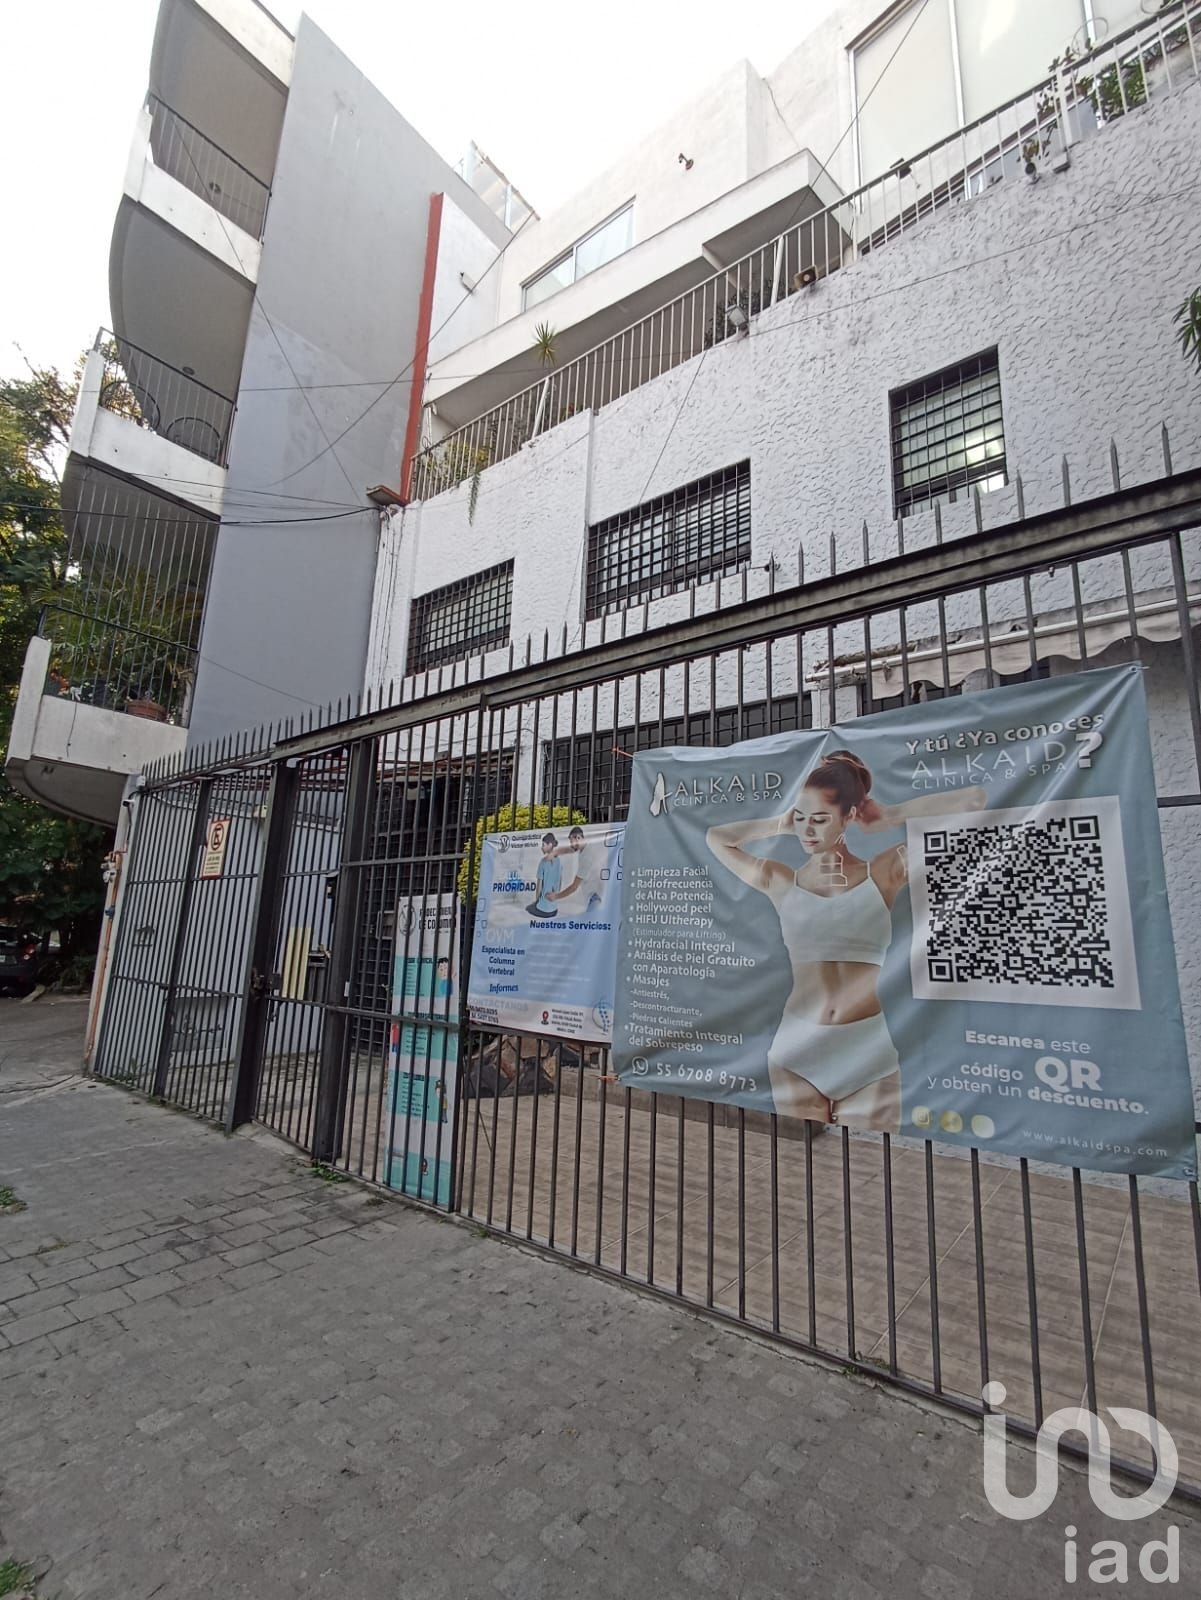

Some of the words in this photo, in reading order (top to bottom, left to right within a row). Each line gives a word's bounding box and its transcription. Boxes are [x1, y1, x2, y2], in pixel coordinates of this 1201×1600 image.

[905, 739, 920, 755] Y
[923, 734, 949, 752] tú
[954, 730, 998, 749] ¿Ya
[1003, 713, 1105, 742] conoces
[1004, 771, 1017, 780] &
[1029, 763, 1067, 777] SPA
[674, 772, 782, 798] ALKAID
[735, 792, 745, 802] &
[753, 790, 782, 801] SPA
[637, 867, 681, 878] Limpieza
[682, 866, 709, 877] Facial
[492, 881, 537, 892] PRIORIDAD
[637, 879, 713, 889] Radiofrecuencia
[635, 891, 646, 901] de
[647, 891, 668, 901] Alta
[670, 891, 714, 902] Potencia
[636, 902, 688, 914] Hollywood
[690, 903, 712, 915] peel
[529, 920, 566, 929] Nuestros
[568, 920, 612, 931] Servicios:
[635, 914, 658, 924] HIFU
[660, 914, 714, 928] Ultherapy
[481, 945, 516, 956] Especialista
[516, 948, 525, 956] en
[634, 938, 688, 951] Hydrafacial
[690, 939, 736, 954] Integral
[488, 957, 515, 966] Columna
[633, 950, 668, 961] Análisis
[670, 951, 682, 962] de
[685, 953, 705, 964] Piel
[707, 954, 756, 968] Gratuito
[487, 966, 515, 977] Vertebral
[632, 963, 648, 973] con
[649, 963, 716, 980] Aparatología
[632, 974, 670, 988] Masajes
[489, 983, 519, 994] Informes
[658, 1016, 693, 1028] Calientes
[629, 1022, 693, 1040] Tratamiento
[695, 1030, 743, 1046] Integral
[628, 1035, 644, 1047] del
[645, 1037, 703, 1053] Sobrepeso
[965, 1029, 1046, 1050] Escanea
[1050, 1037, 1092, 1054] este
[655, 1062, 672, 1077] 55
[677, 1063, 713, 1082] 6708
[719, 1070, 757, 1092] 8773
[960, 1061, 1024, 1083] código
[1034, 1055, 1104, 1094] QR
[927, 1076, 937, 1090] y
[941, 1075, 992, 1095] obten
[998, 1085, 1022, 1099] un
[1027, 1086, 1150, 1115] descuento.
[1022, 1129, 1168, 1158] www.alkaidspa.com
